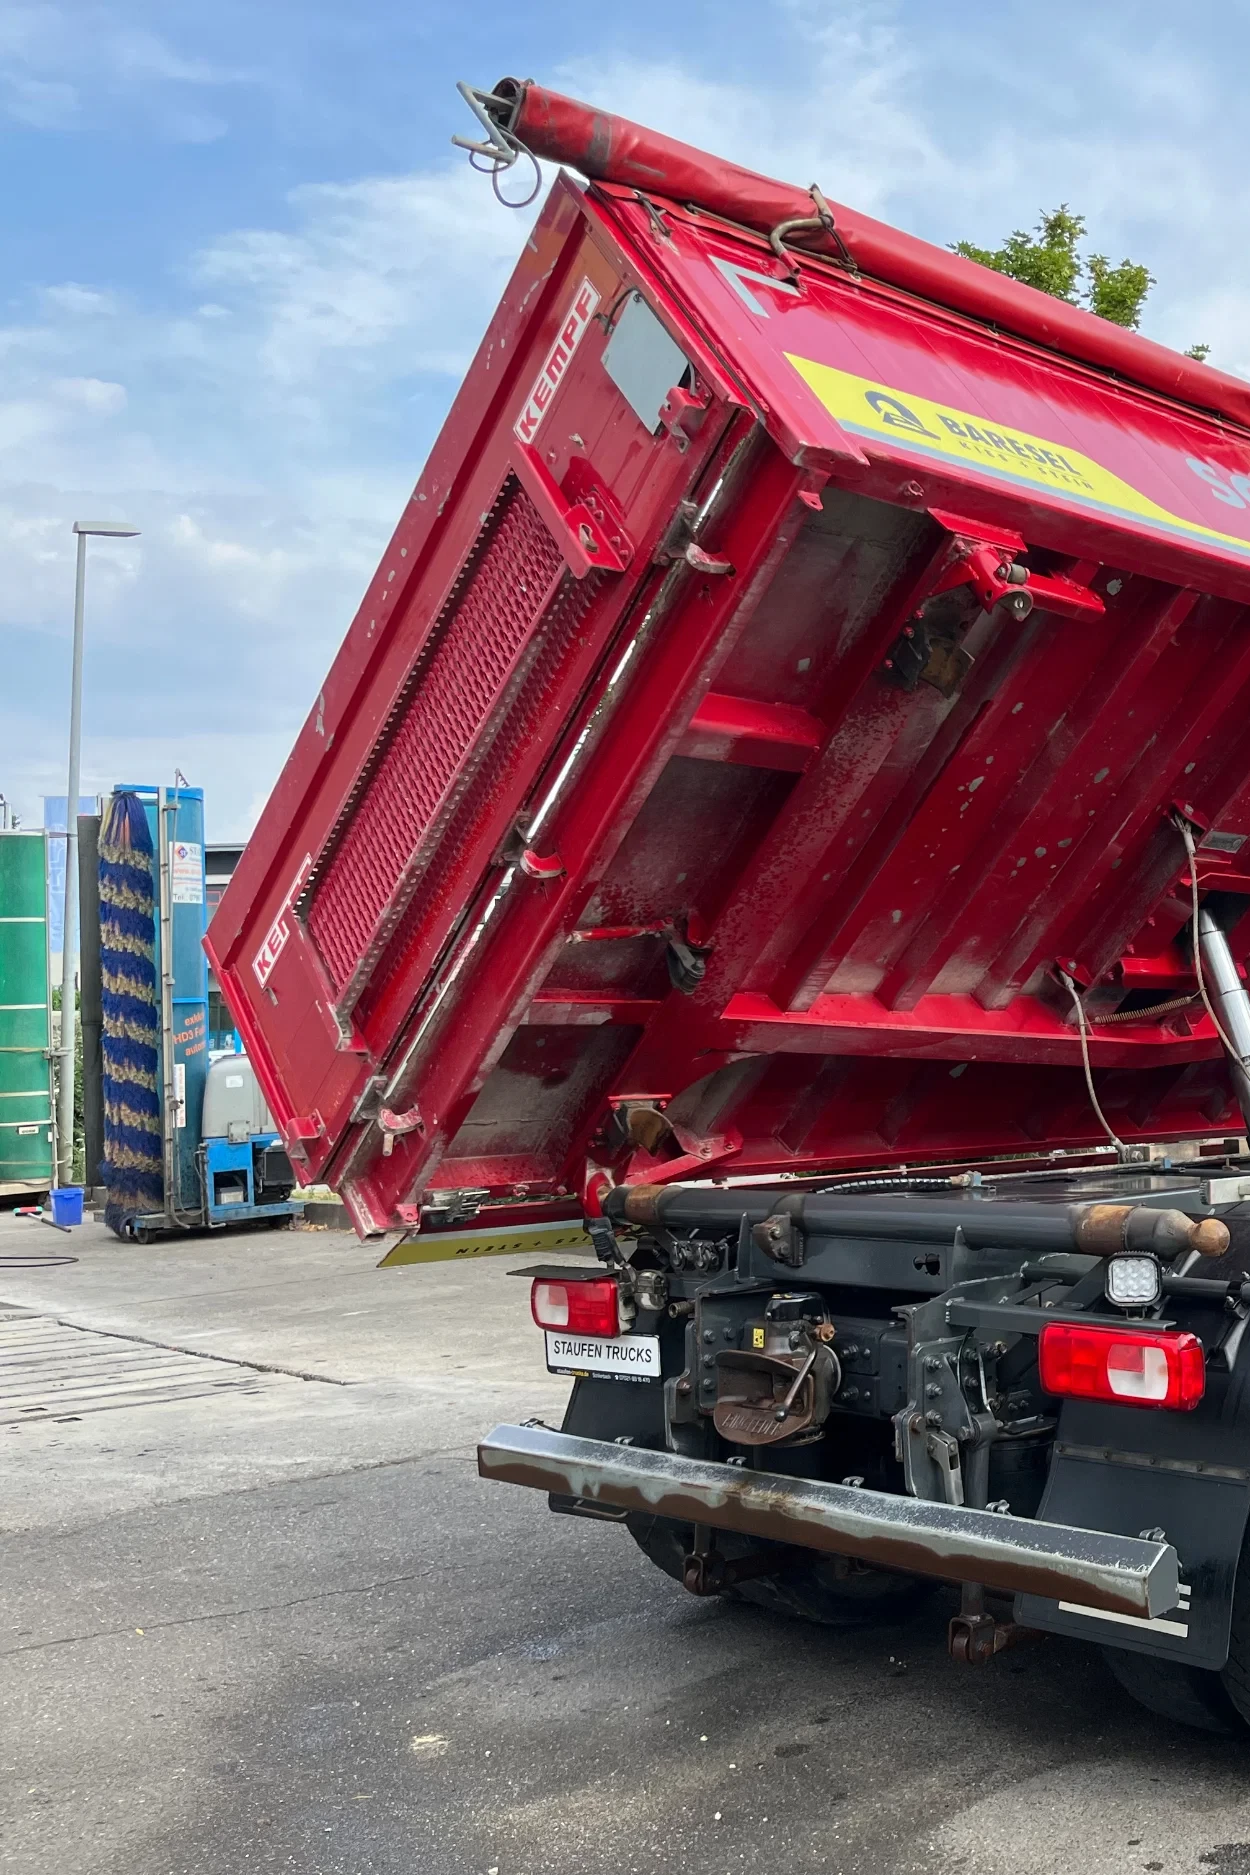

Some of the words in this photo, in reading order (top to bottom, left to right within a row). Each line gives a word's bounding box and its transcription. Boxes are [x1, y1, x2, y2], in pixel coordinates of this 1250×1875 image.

[517, 281, 597, 439] KEMPF
[936, 413, 1083, 476] BARESEL
[1038, 466, 1094, 490] STEIN
[554, 1340, 602, 1358] STAUFEN
[605, 1345, 652, 1363] TRUCKS
